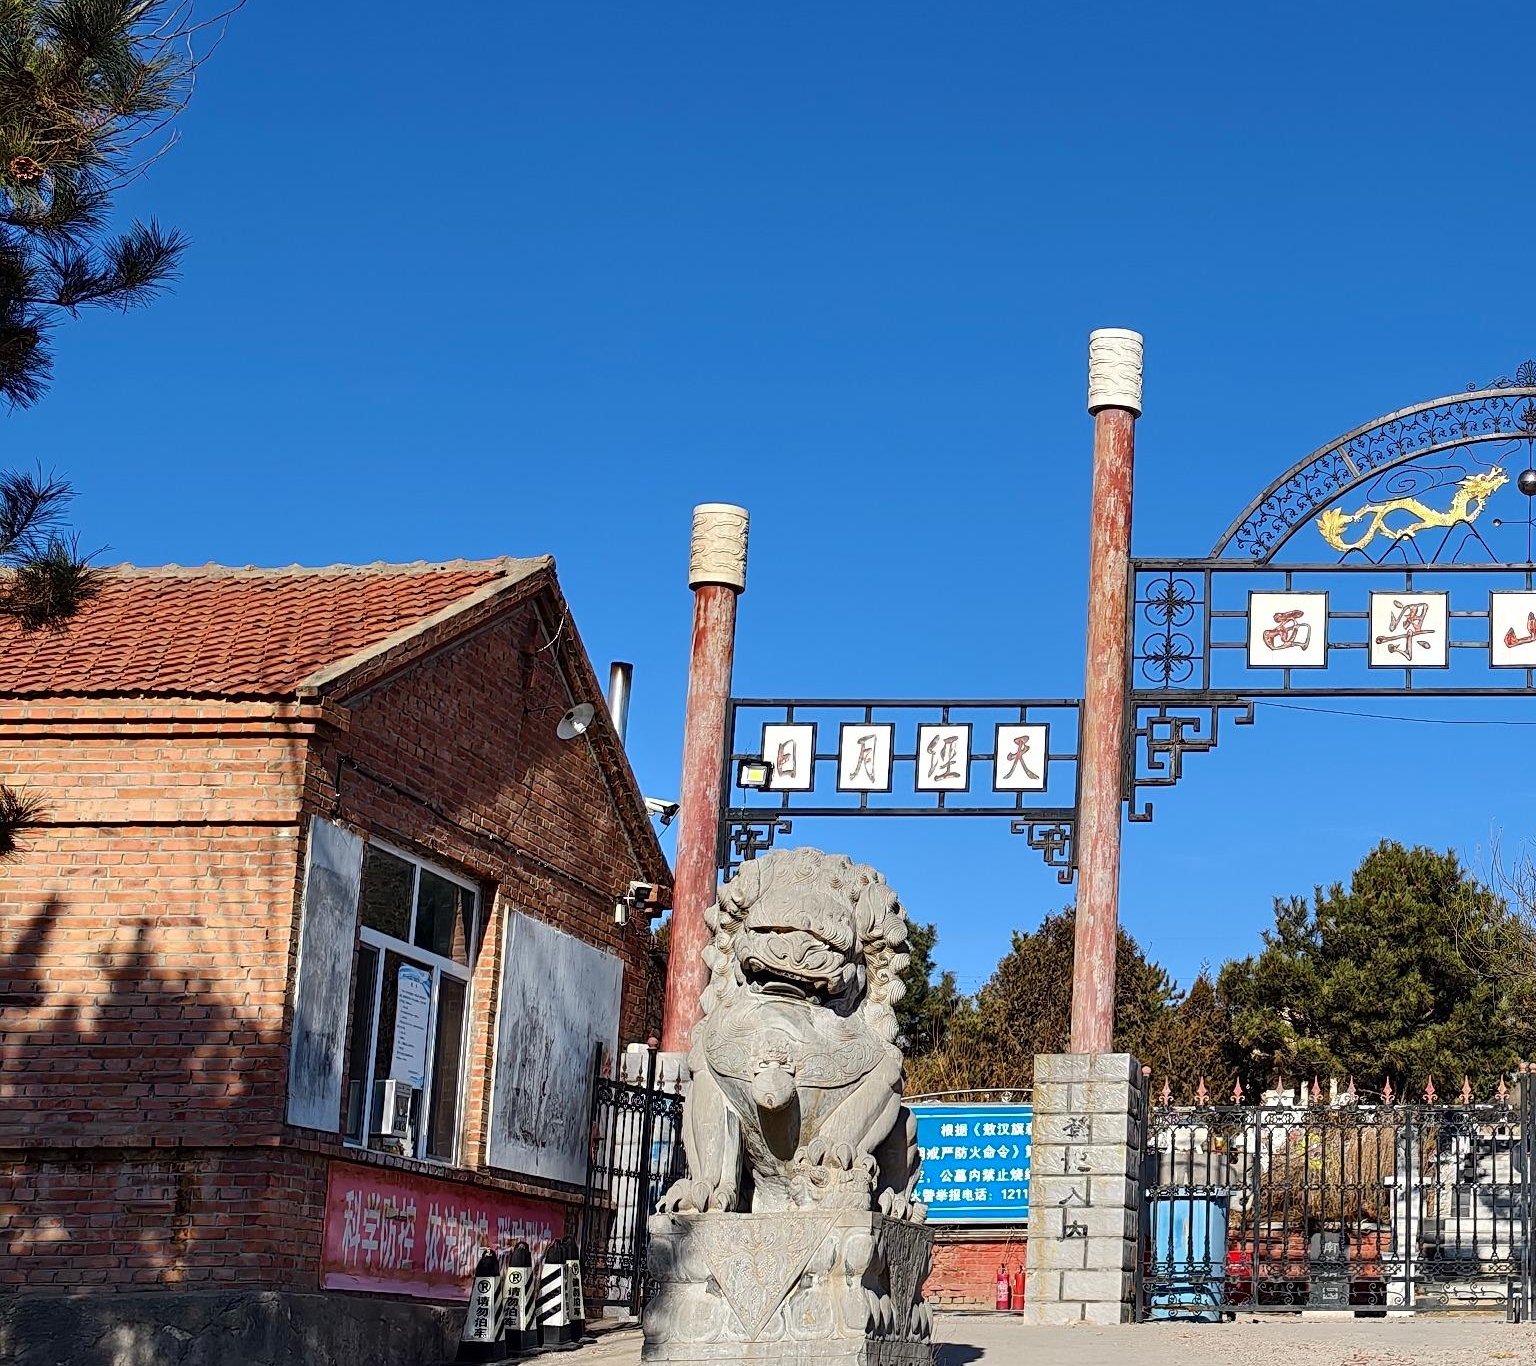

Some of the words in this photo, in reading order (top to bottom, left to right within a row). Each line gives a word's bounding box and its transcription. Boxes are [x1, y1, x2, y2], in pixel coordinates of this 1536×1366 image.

[474, 1296, 490, 1338] 请勿泊车
[504, 1287, 521, 1327] 请勿泊车
